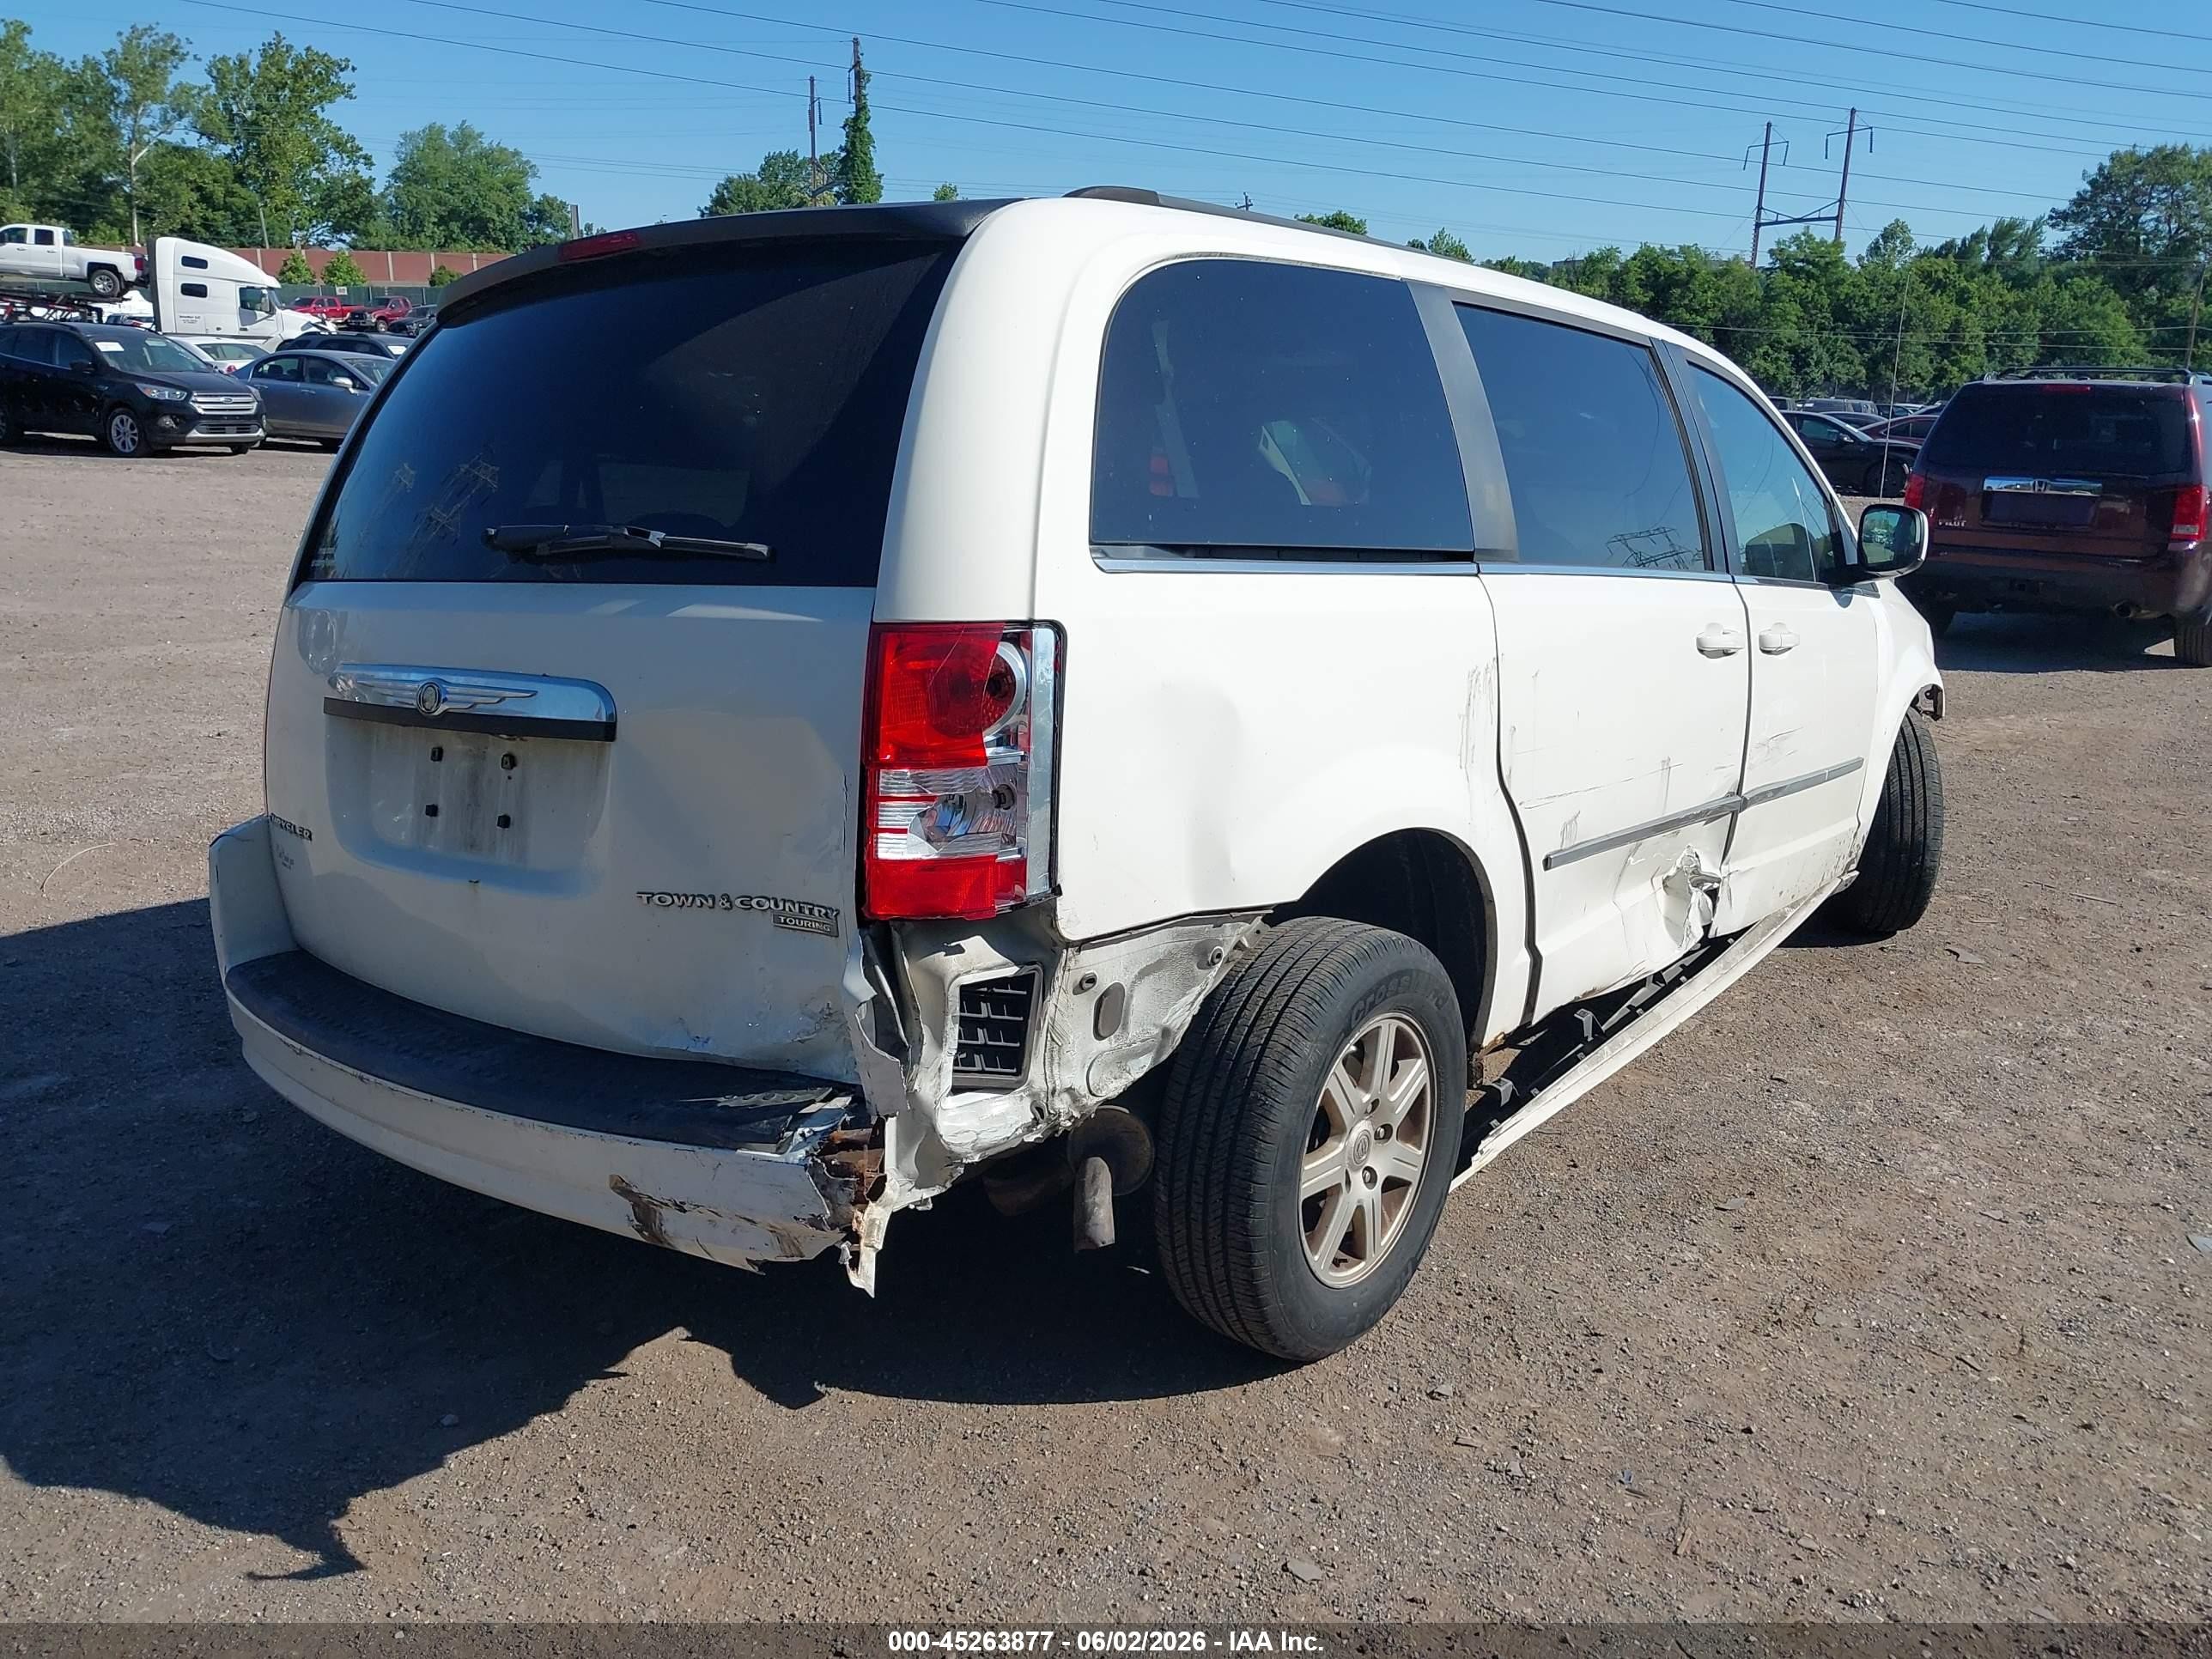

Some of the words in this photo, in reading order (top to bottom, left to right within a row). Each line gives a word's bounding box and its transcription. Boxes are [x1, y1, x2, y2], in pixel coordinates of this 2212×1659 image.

[635, 891, 716, 909] TOWN
[719, 892, 733, 910] &
[734, 895, 841, 920] COUNTRY
[778, 915, 831, 933] TOURING
